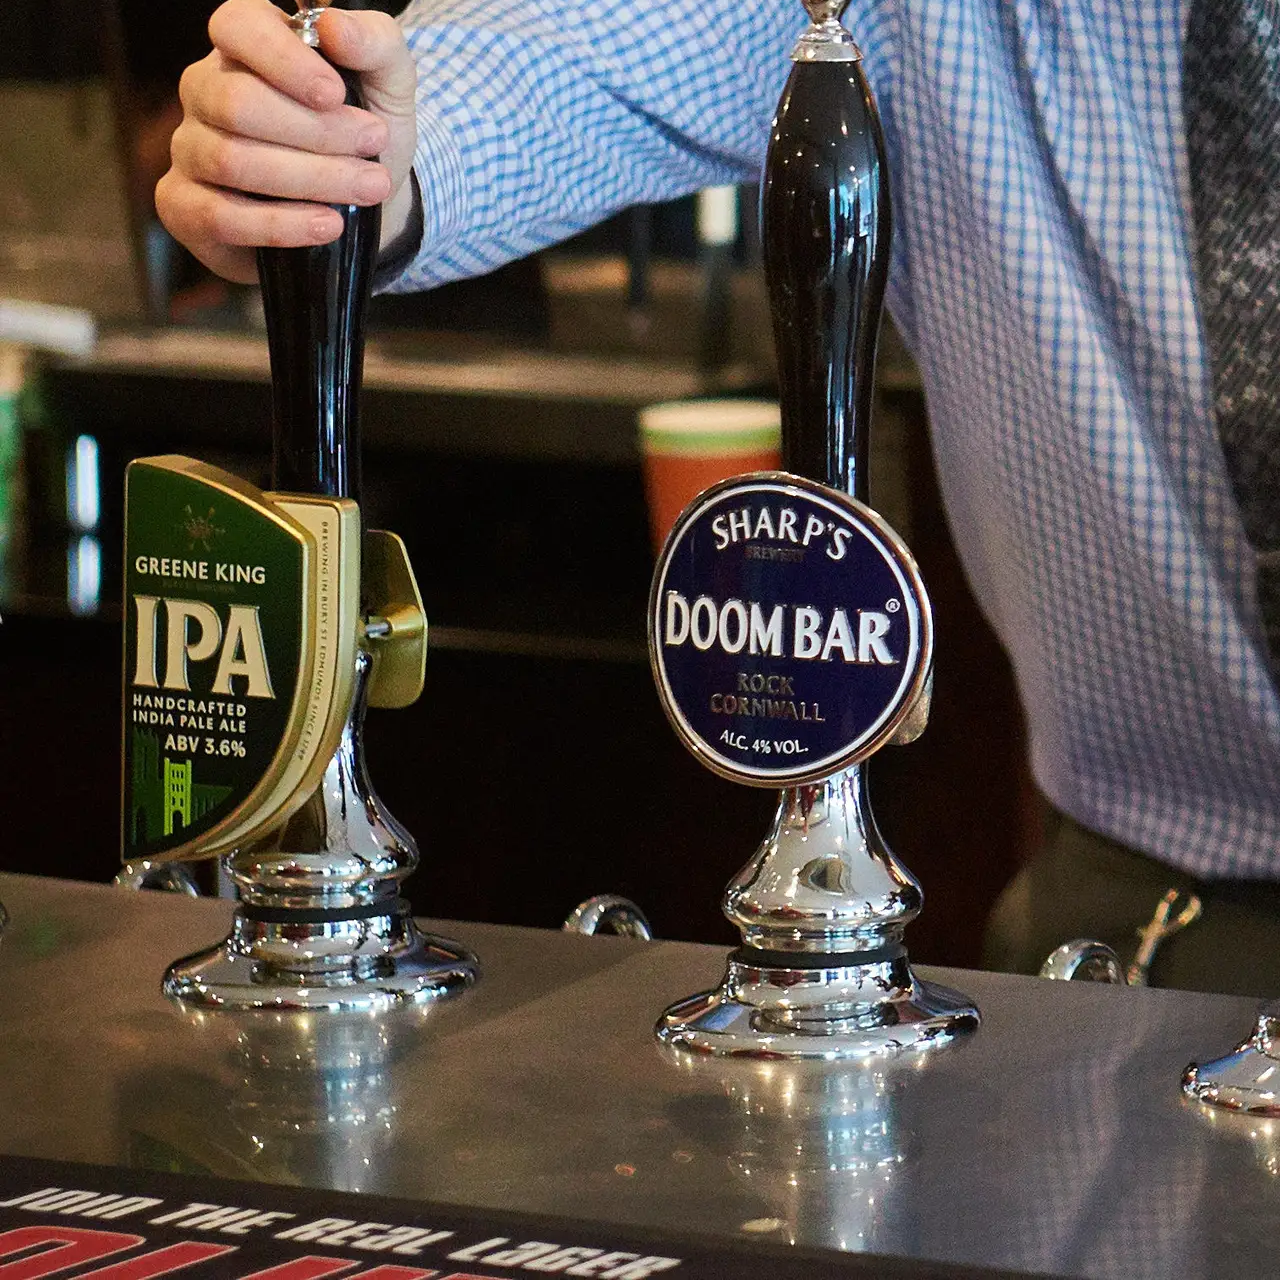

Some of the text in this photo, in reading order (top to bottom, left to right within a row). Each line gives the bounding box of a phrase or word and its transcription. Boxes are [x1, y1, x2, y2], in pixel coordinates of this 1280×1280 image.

[321, 521, 329, 575] BREWING
[711, 506, 853, 561] SHARP'S
[135, 556, 209, 580] GREENE
[215, 563, 266, 585] KING
[321, 579, 328, 591] IN
[320, 629, 327, 640] ST
[665, 590, 784, 658] DOOM
[132, 594, 277, 700] IPA
[314, 645, 328, 701] EDMUNDS
[737, 673, 795, 696] ROCK
[133, 693, 247, 717] HANDCRAFTED
[709, 692, 826, 722] CORNWALL
[133, 709, 246, 734] INDIA PALE ALE
[306, 705, 319, 736] SINCE
[164, 734, 246, 758] ABV 3.6%
[720, 729, 809, 755] ALC. 4% VOL.
[0, 1187, 164, 1220] JOIN
[147, 1202, 296, 1235] THE
[273, 1217, 454, 1255] REAL
[446, 1237, 682, 1280] LAGER
